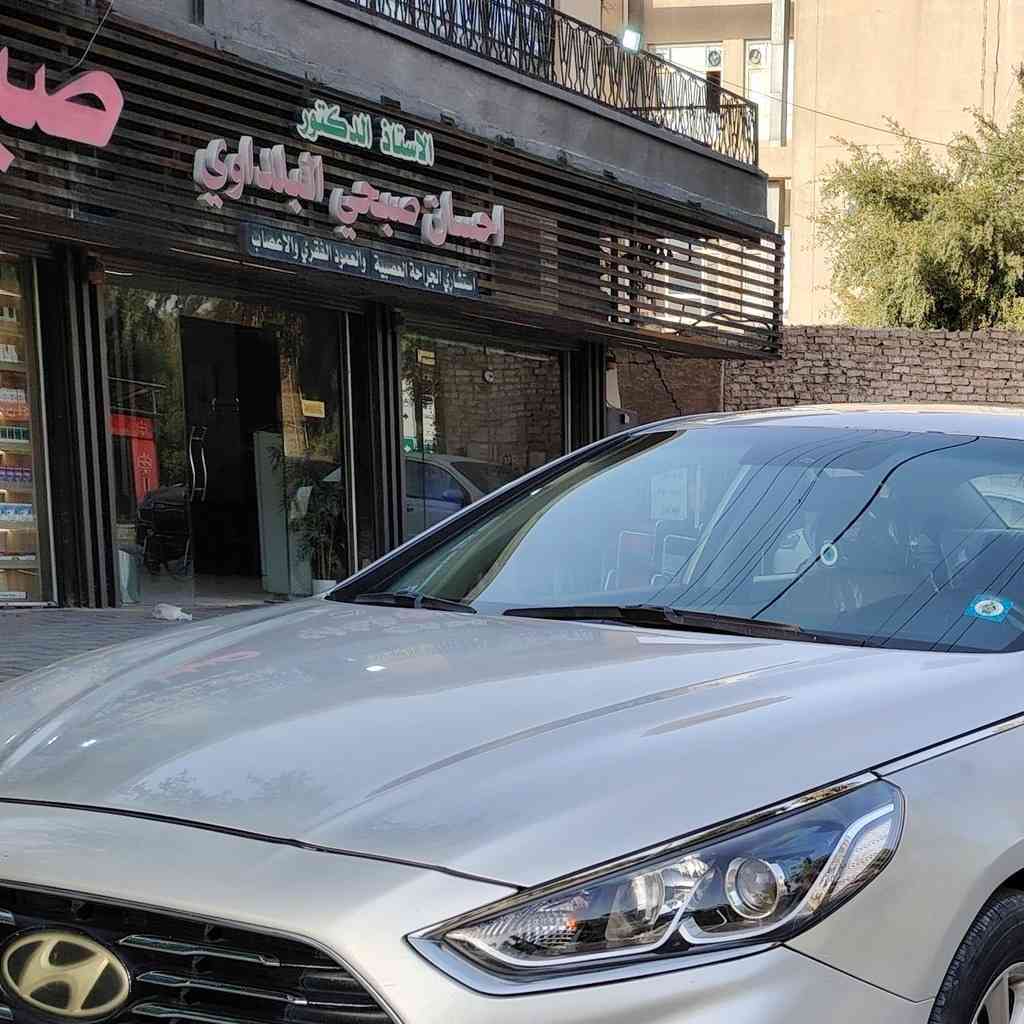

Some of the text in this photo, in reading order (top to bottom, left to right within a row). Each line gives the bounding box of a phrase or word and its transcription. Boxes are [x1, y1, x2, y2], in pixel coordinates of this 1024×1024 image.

[296, 99, 435, 167] الاستاذ الدكتور
[329, 181, 420, 240] صبحي
[421, 191, 505, 247] احسان
